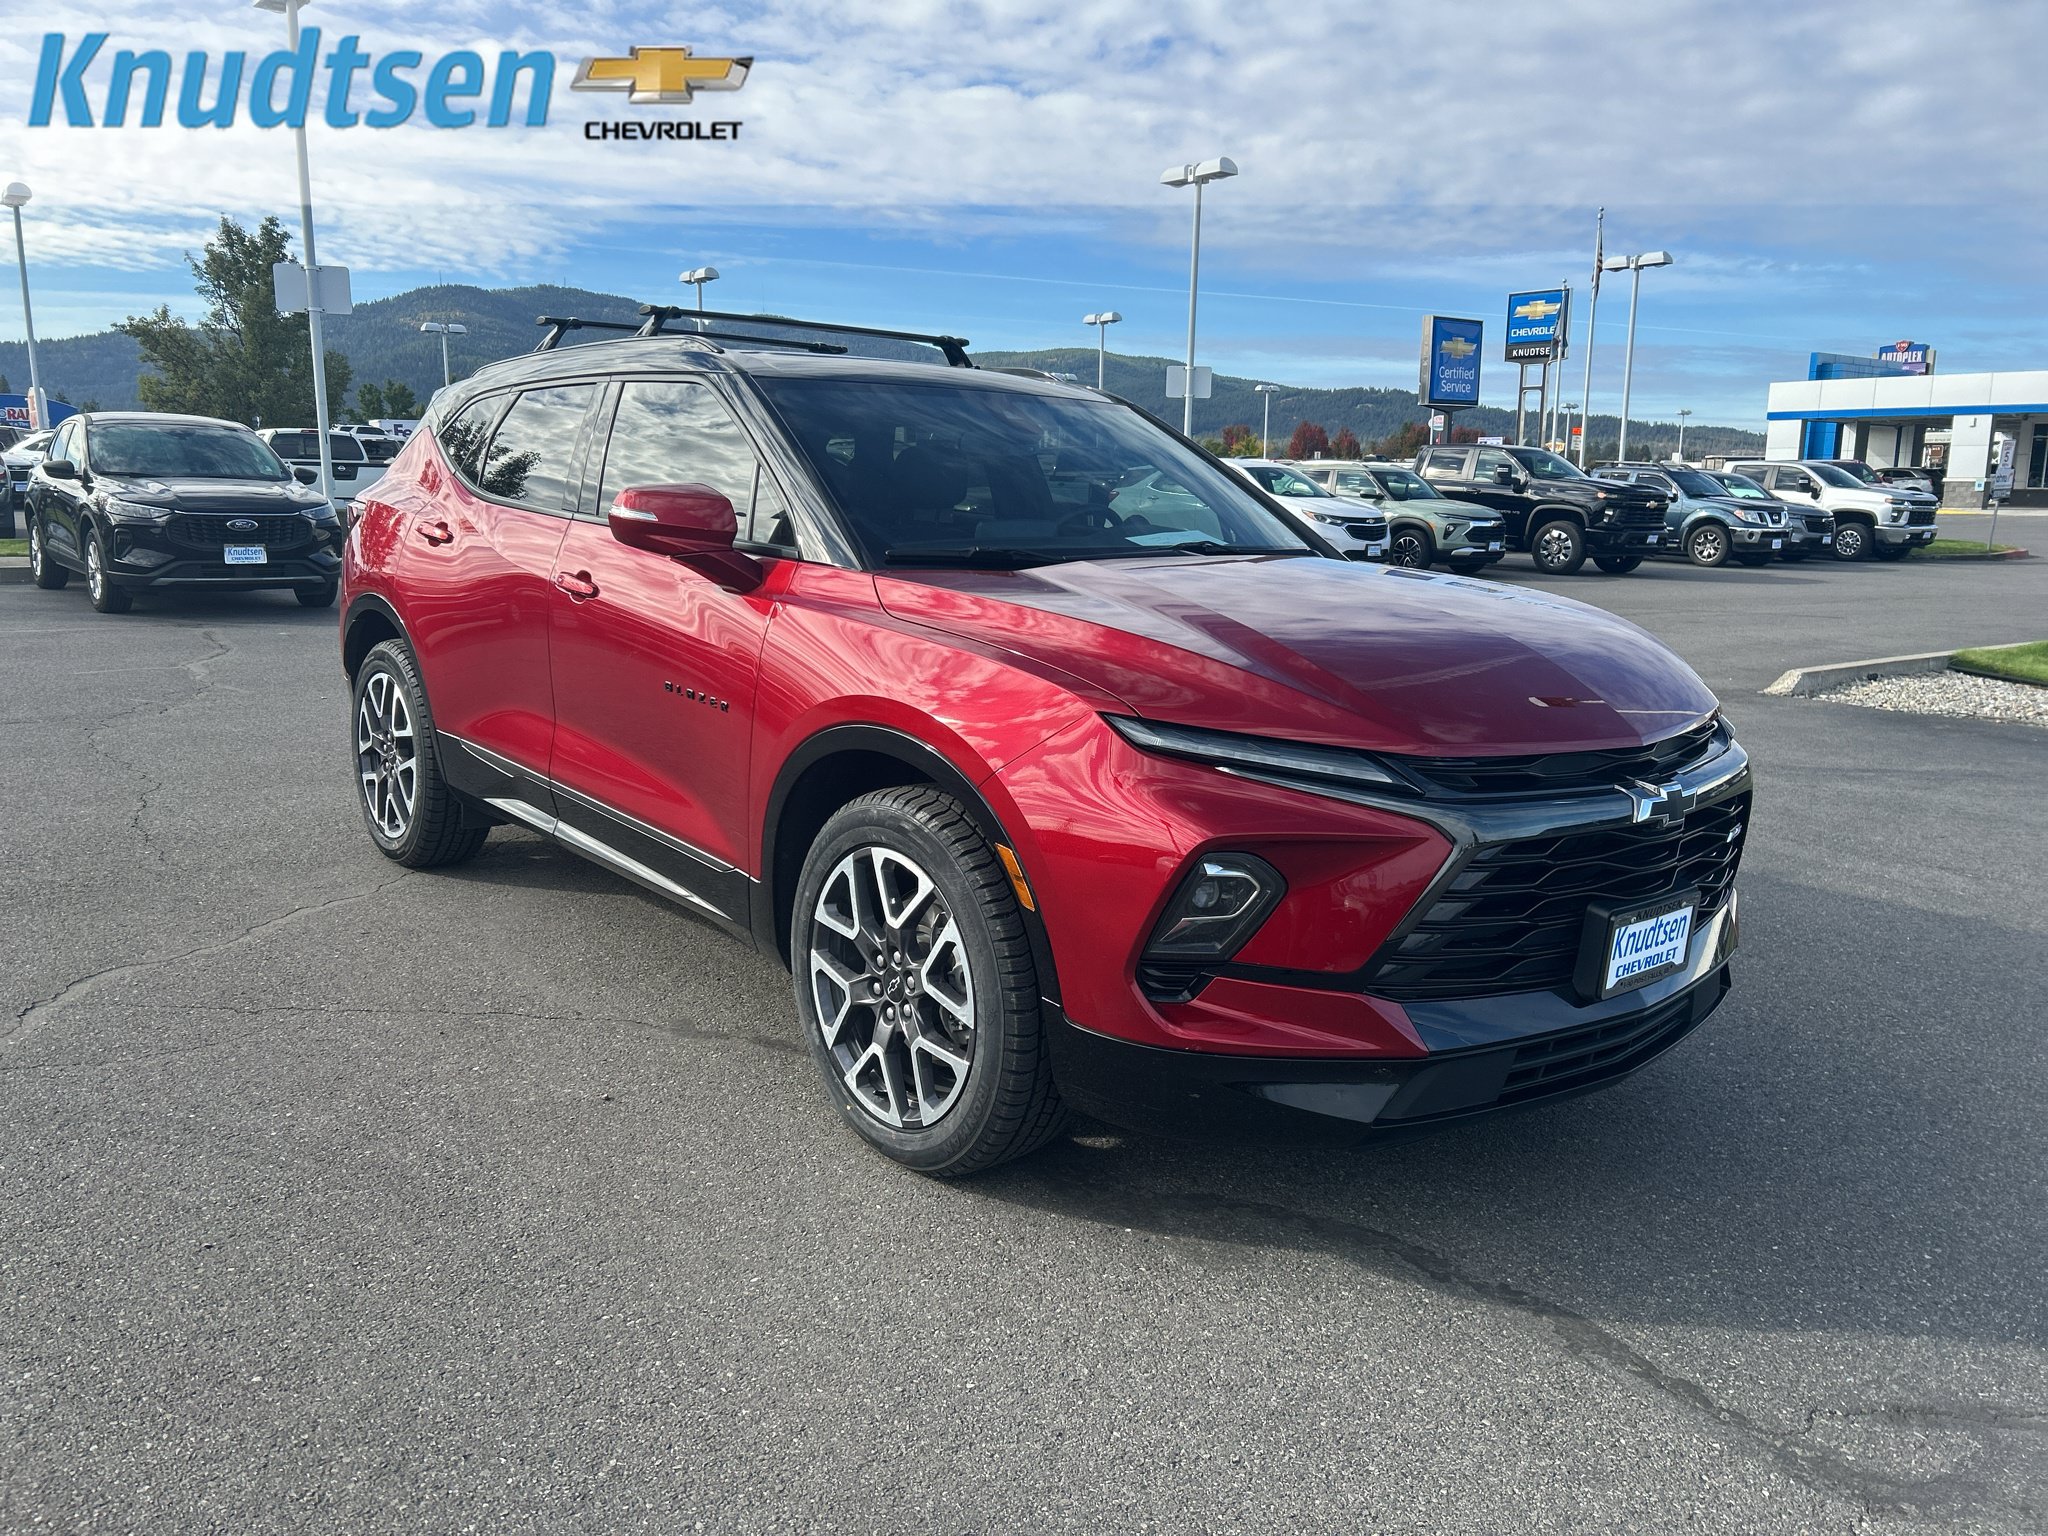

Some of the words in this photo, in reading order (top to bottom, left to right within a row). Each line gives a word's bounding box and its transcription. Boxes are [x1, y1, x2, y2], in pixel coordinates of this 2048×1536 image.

[1511, 326, 1556, 337] CHEVROLE
[1512, 347, 1551, 357] KNUDTSE
[1881, 350, 1922, 362] AUTOPLEX
[1439, 366, 1475, 380] Certified
[1441, 380, 1471, 393] Service
[228, 547, 263, 556] Knudtsen
[664, 680, 729, 713] BLAZER
[1612, 915, 1687, 961] Knudtsen
[1616, 946, 1678, 979] CHEVROLET
